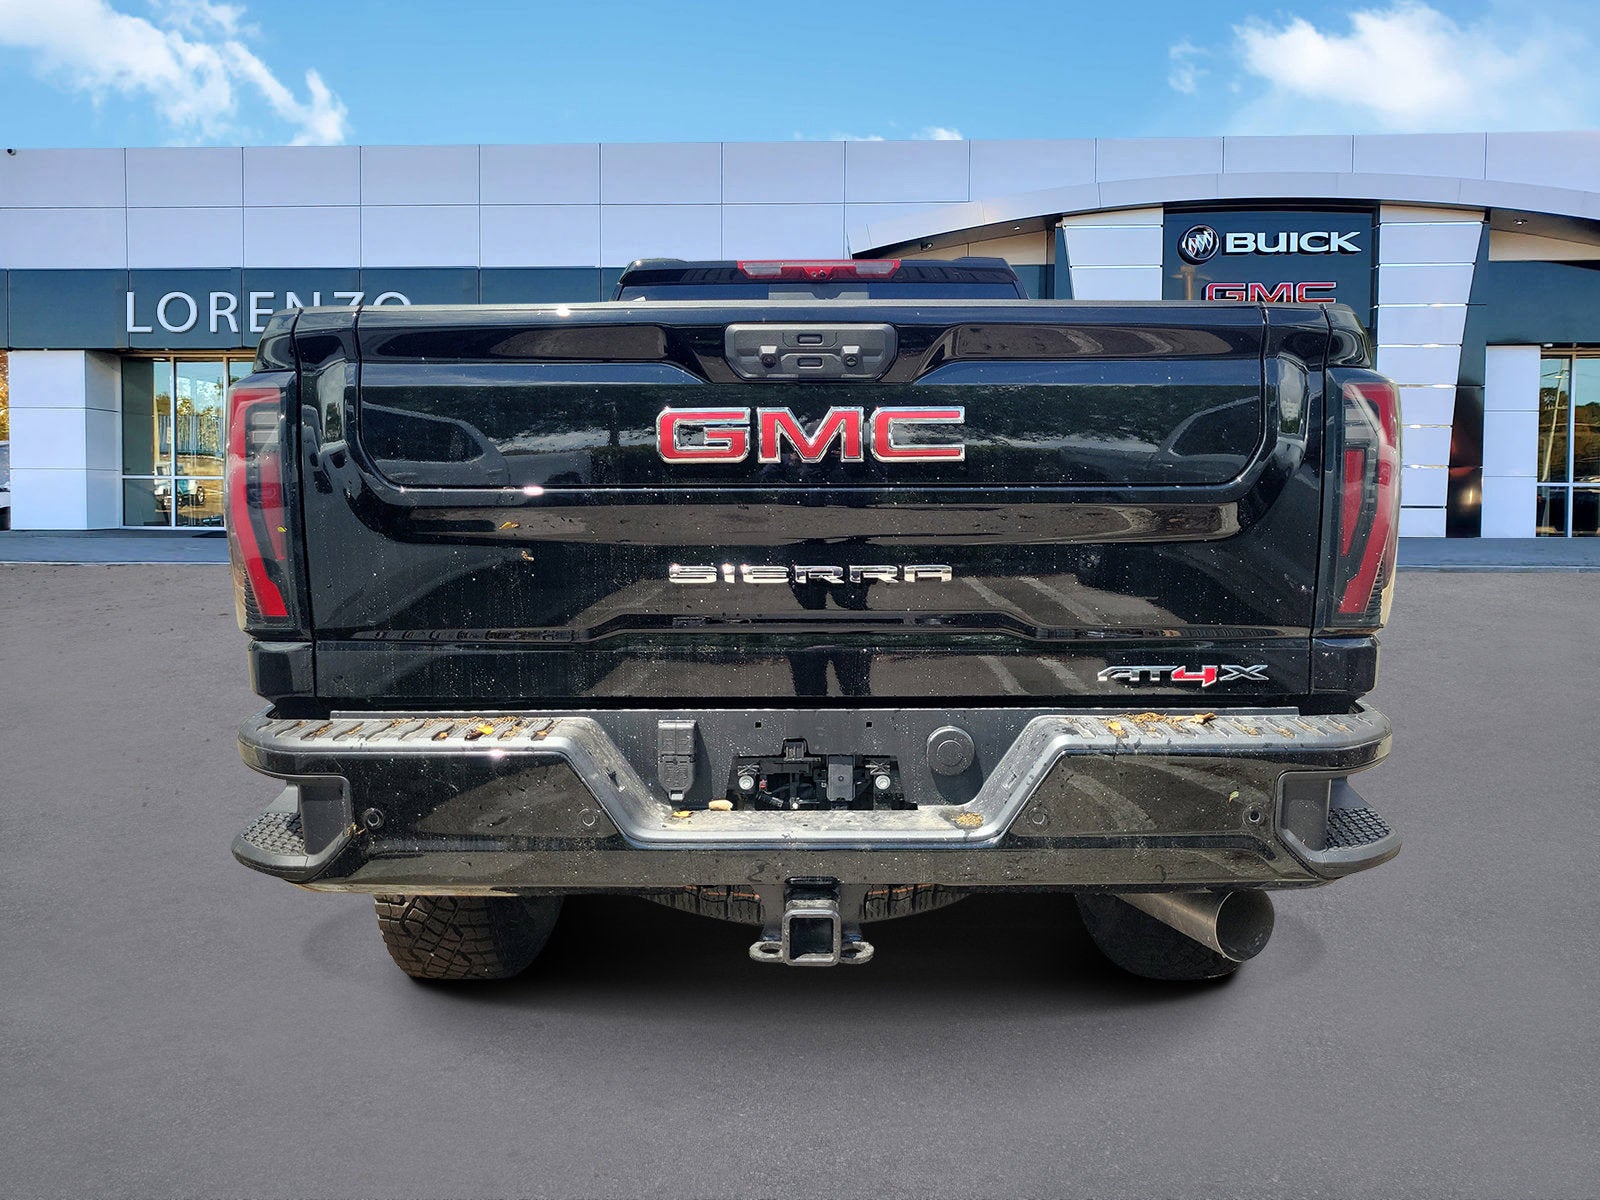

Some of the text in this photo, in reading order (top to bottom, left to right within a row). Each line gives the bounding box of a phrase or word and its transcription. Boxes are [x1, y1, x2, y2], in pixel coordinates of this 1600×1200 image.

[1224, 231, 1362, 254] BUICK
[1204, 281, 1337, 303] GMC
[655, 405, 966, 464] GMC
[668, 564, 953, 584] SIERRA
[1096, 665, 1270, 687] AT4X
